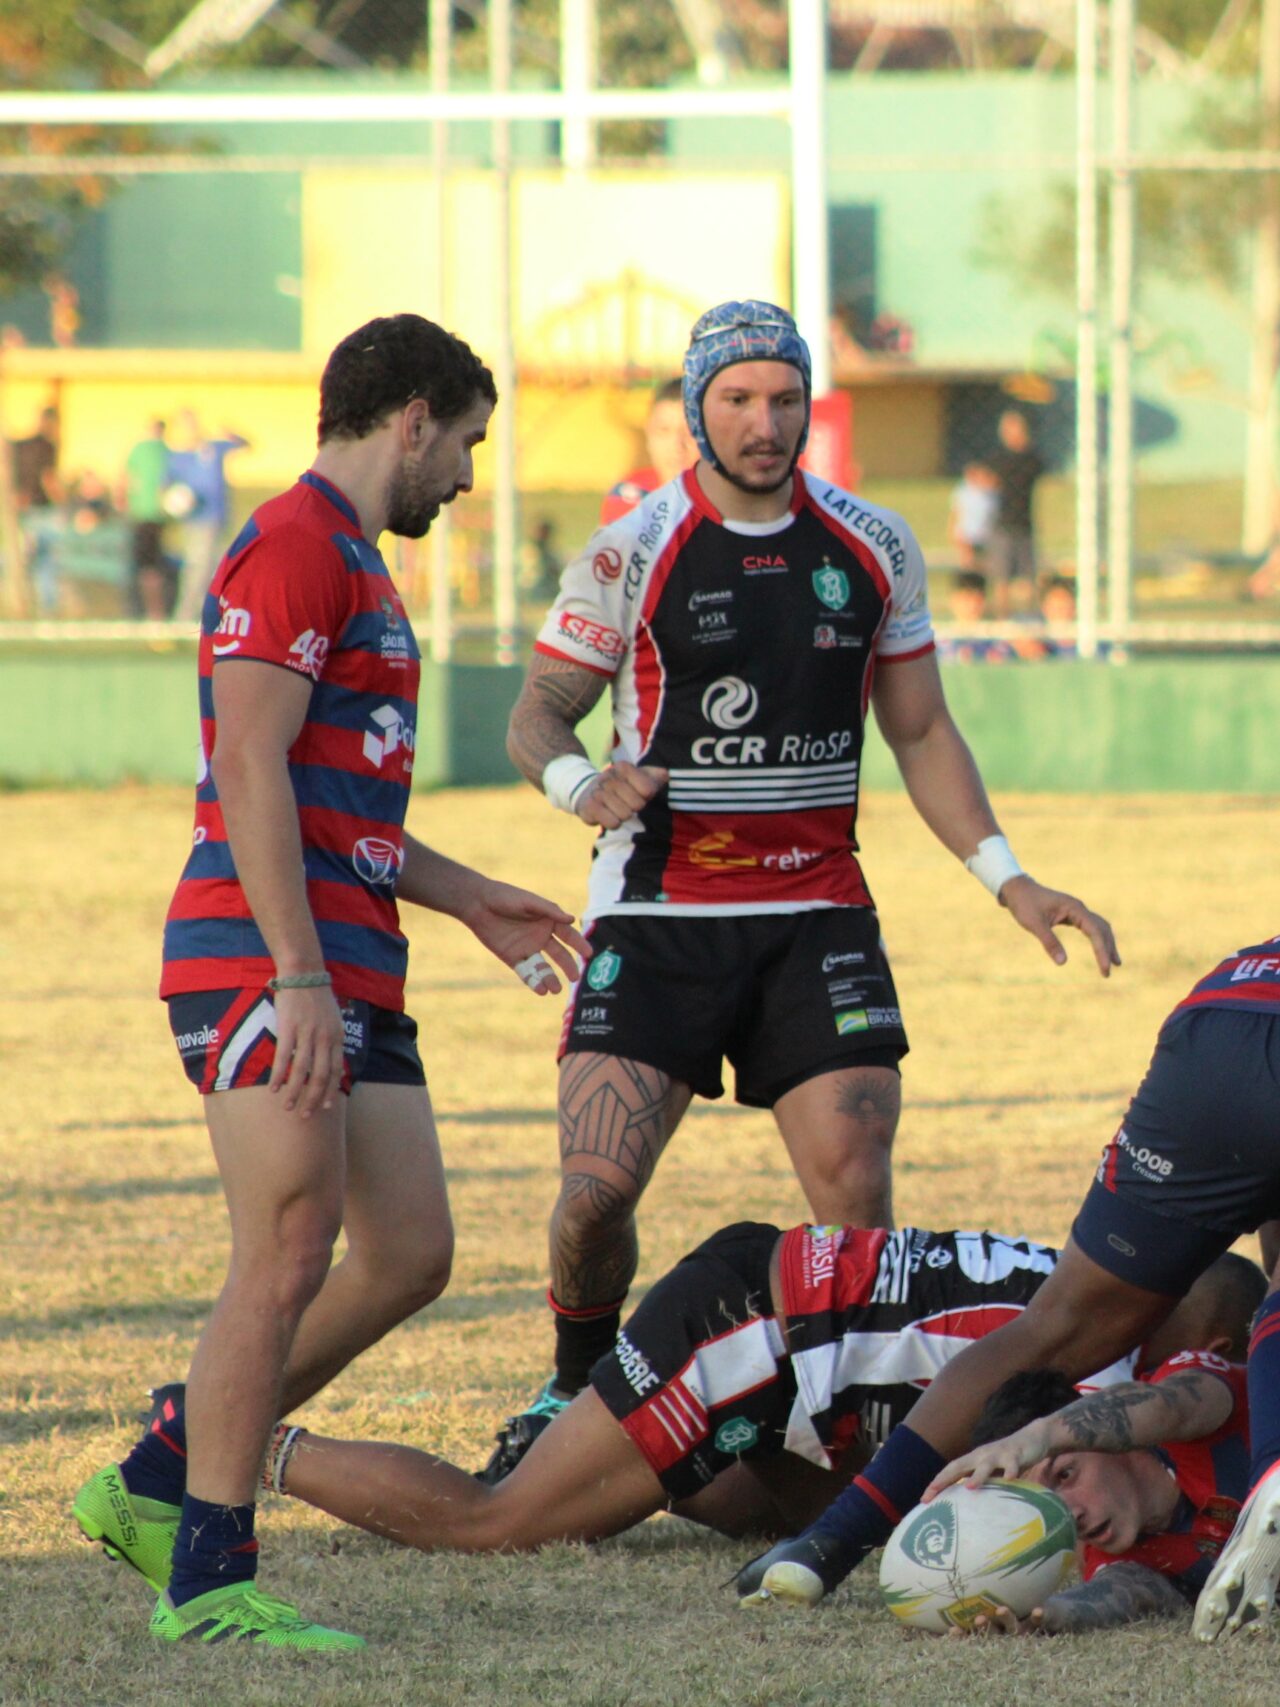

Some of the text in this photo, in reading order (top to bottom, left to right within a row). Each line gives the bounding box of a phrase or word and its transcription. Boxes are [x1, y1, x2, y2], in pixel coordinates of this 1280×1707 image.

[742, 555, 787, 568] CNA
[284, 659, 311, 673] ANOS
[690, 730, 851, 765] CCR RioSP
